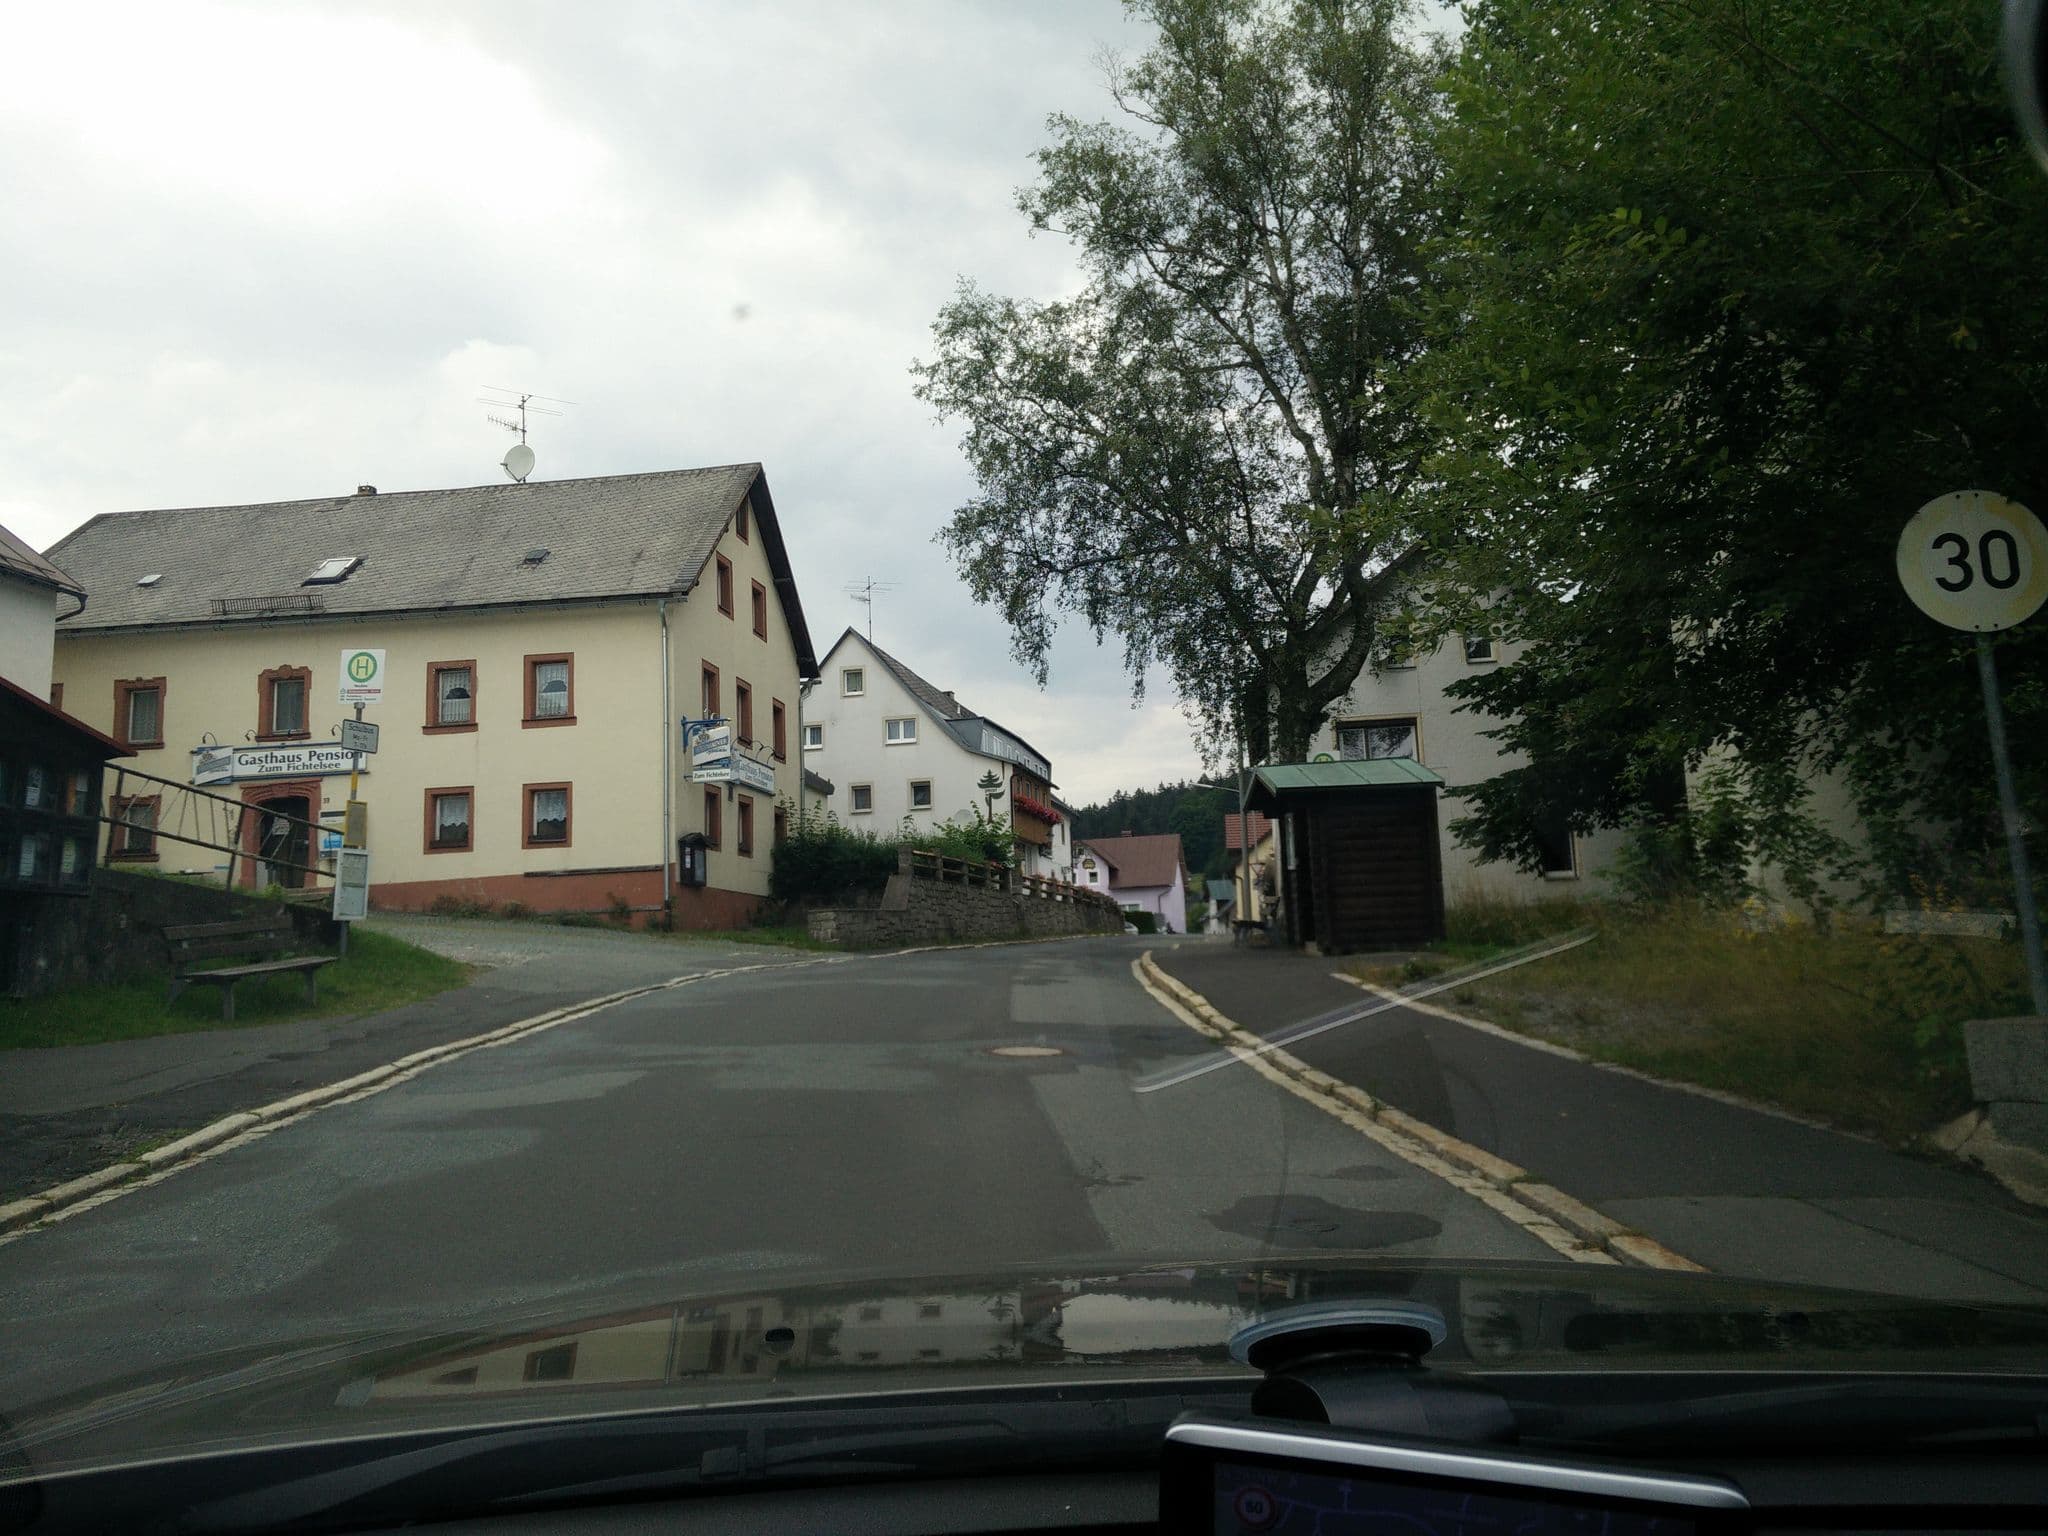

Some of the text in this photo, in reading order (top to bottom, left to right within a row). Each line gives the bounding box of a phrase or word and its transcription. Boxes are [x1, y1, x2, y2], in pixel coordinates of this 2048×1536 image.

[1931, 529, 2021, 593] 30
[356, 659, 369, 676] H
[238, 752, 302, 766] Gasthaus
[257, 761, 341, 773] Zum Fichtelsee
